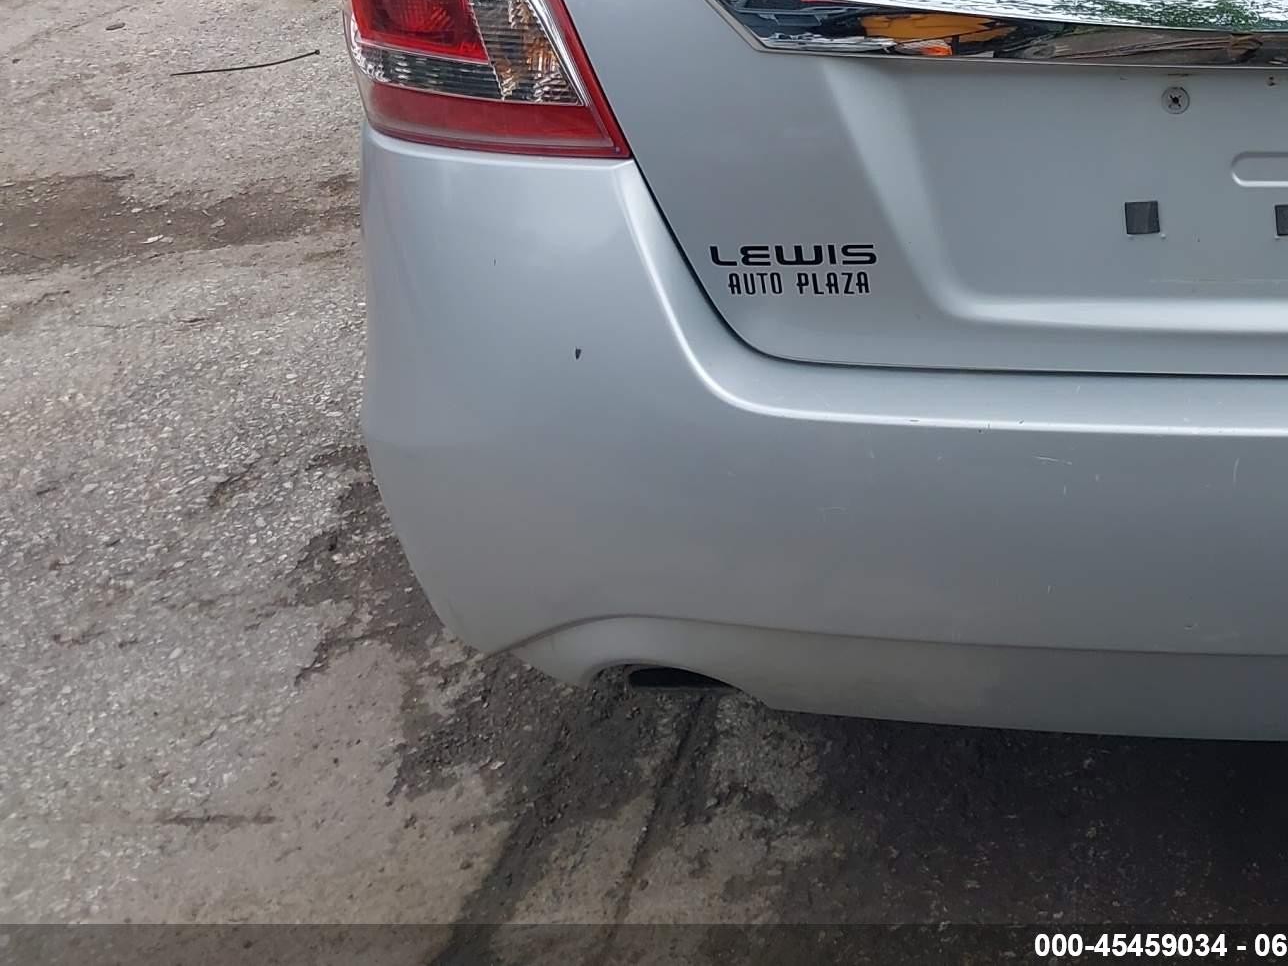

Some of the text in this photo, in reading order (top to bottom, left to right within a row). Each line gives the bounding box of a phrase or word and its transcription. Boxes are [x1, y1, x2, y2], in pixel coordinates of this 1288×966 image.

[709, 244, 877, 266] LEWIS
[728, 271, 870, 295] AUTO PLAZA
